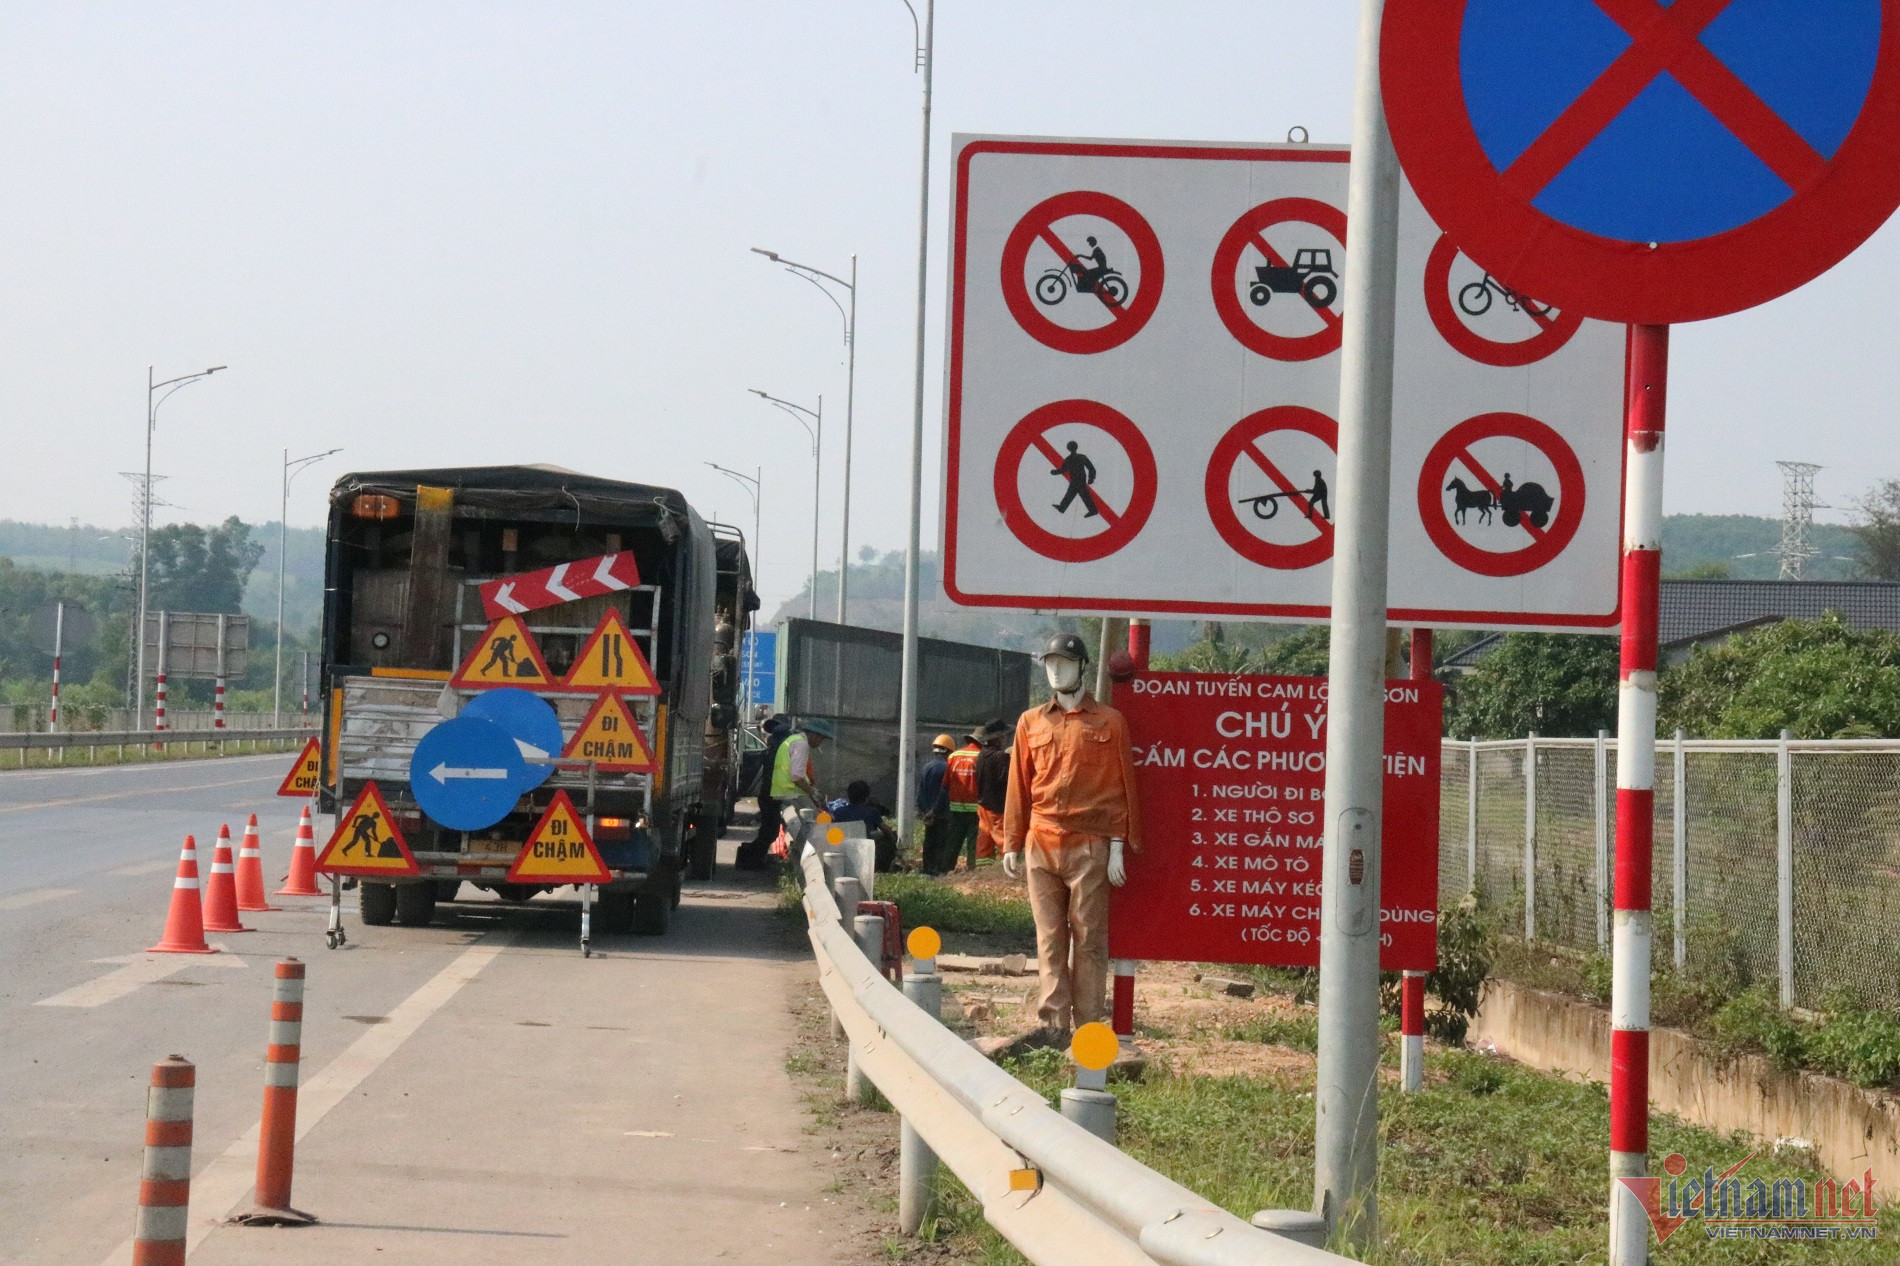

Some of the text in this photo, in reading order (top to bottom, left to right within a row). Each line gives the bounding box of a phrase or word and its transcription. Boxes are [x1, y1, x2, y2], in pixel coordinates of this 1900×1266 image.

[1195, 676, 1251, 697] TUYẾN
[1257, 683, 1303, 699] CAM
[602, 716, 618, 731] ĐI
[1215, 702, 1326, 739] CHÚ Ý
[583, 739, 633, 762] CHẬM
[1131, 740, 1186, 767] CẤM
[1193, 744, 1251, 769] CÁC
[1257, 751, 1326, 772] PHƯƠ
[307, 761, 318, 771] ĐI
[1213, 781, 1278, 799] NGƯỜI
[1284, 787, 1303, 800] ĐI
[1191, 806, 1315, 825] 2. XE THÔ SƠ
[551, 820, 567, 835] ĐI
[1191, 832, 1208, 845] 3.
[1214, 832, 1238, 846] XE
[1243, 827, 1290, 847] GẮN
[533, 839, 585, 862] CHẬM
[1191, 854, 1309, 872] 4. XE MÔ TÔ
[1190, 879, 1207, 892] 5.
[1212, 880, 1236, 893] XE
[1242, 878, 1287, 895] MÁY
[1189, 903, 1207, 916] 6.
[1212, 904, 1235, 917] XE
[1241, 901, 1287, 918] MÁY
[1286, 927, 1311, 946] ĐỘ
